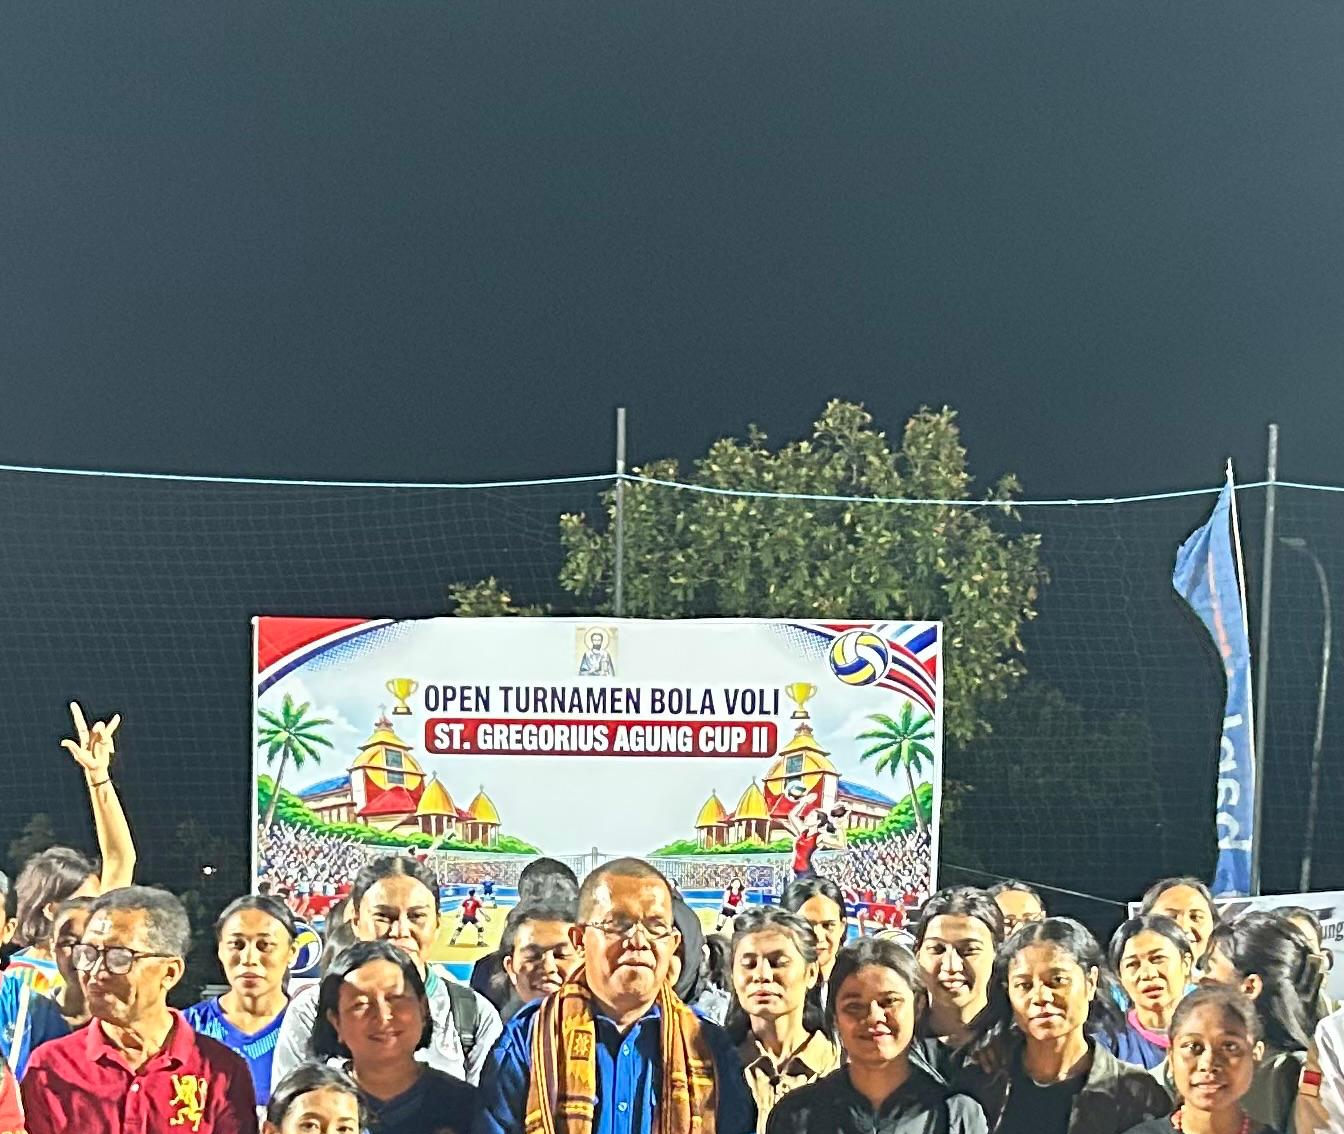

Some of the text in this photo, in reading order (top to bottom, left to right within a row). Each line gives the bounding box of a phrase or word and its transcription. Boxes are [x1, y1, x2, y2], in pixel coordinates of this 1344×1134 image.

[424, 685, 780, 716] OPEN TURNAMEN BOLA VOLI
[434, 722, 769, 754] ST. GREGORIUS AGUNG CUP II
